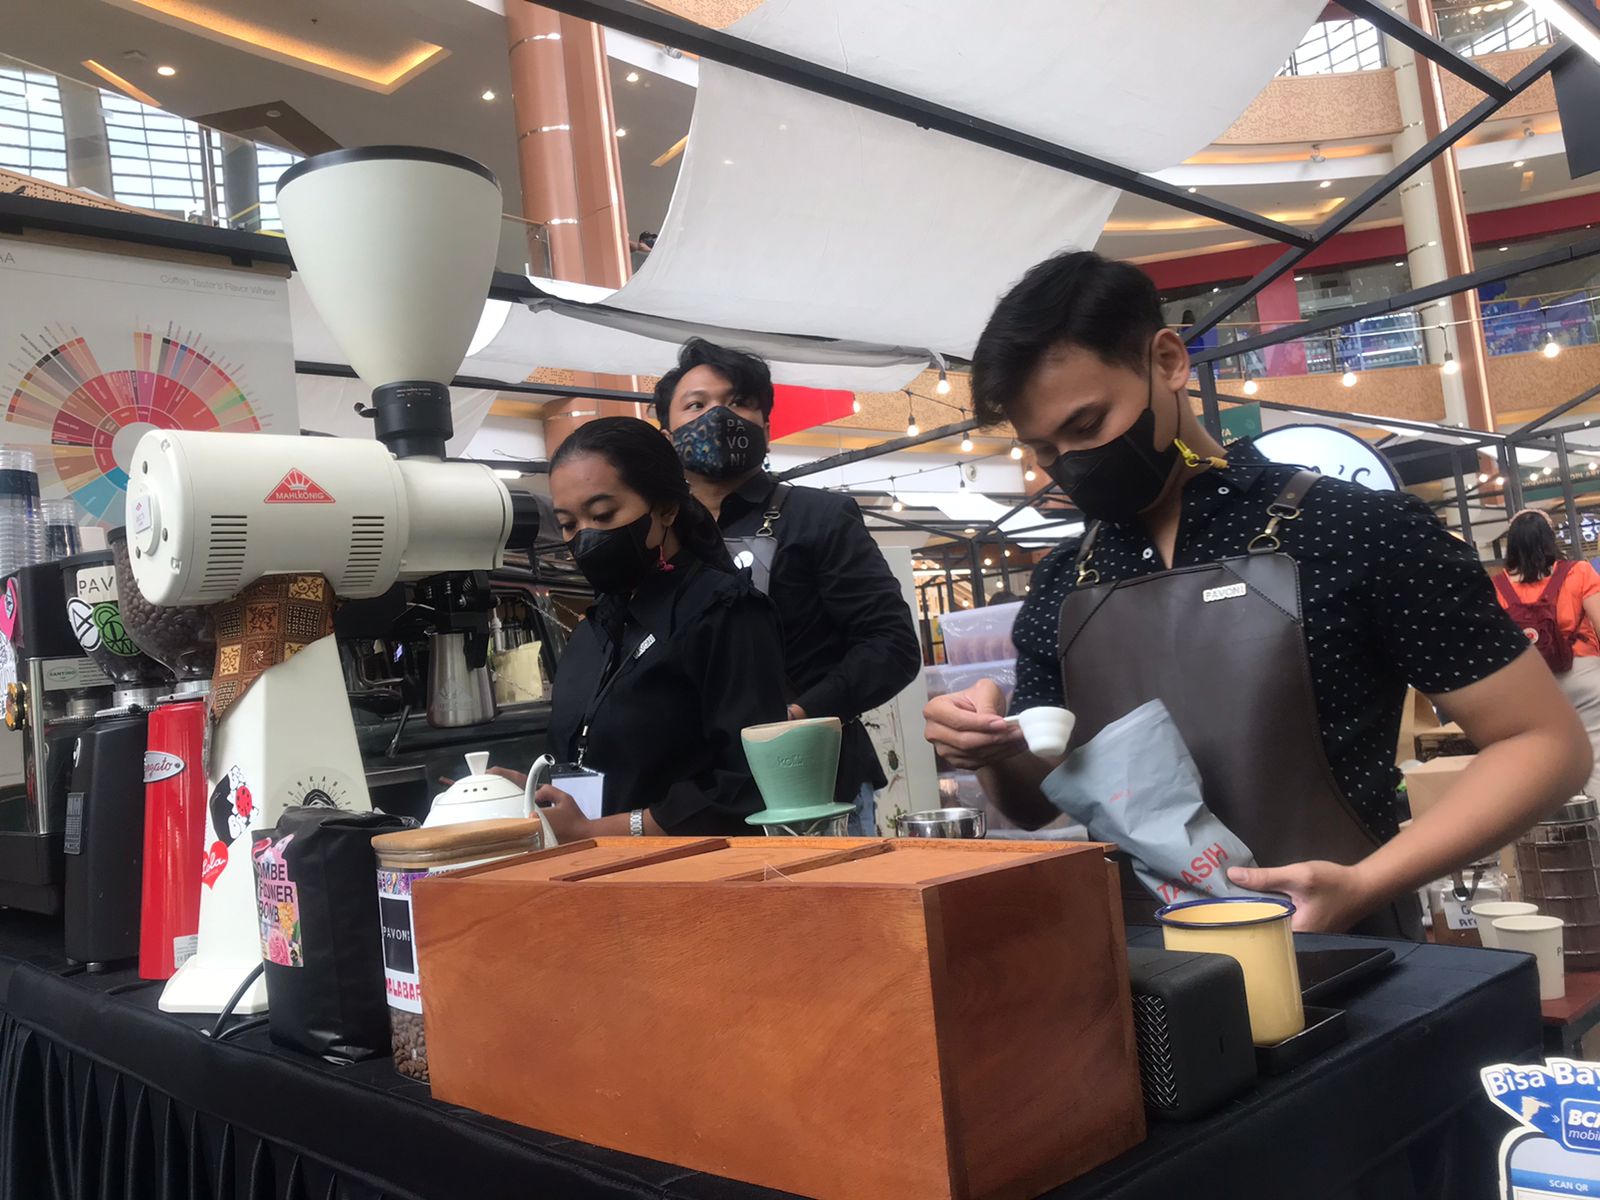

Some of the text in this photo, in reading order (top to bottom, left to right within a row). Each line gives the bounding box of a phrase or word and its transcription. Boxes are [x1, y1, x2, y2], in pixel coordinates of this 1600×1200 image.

[160, 274, 189, 286] Coffee
[223, 282, 248, 293] Flavor
[251, 286, 276, 296] Wheel
[726, 436, 749, 449] VO
[1486, 1068, 1546, 1096] Bisa
[1549, 1179, 1589, 1192] SCAN QR
